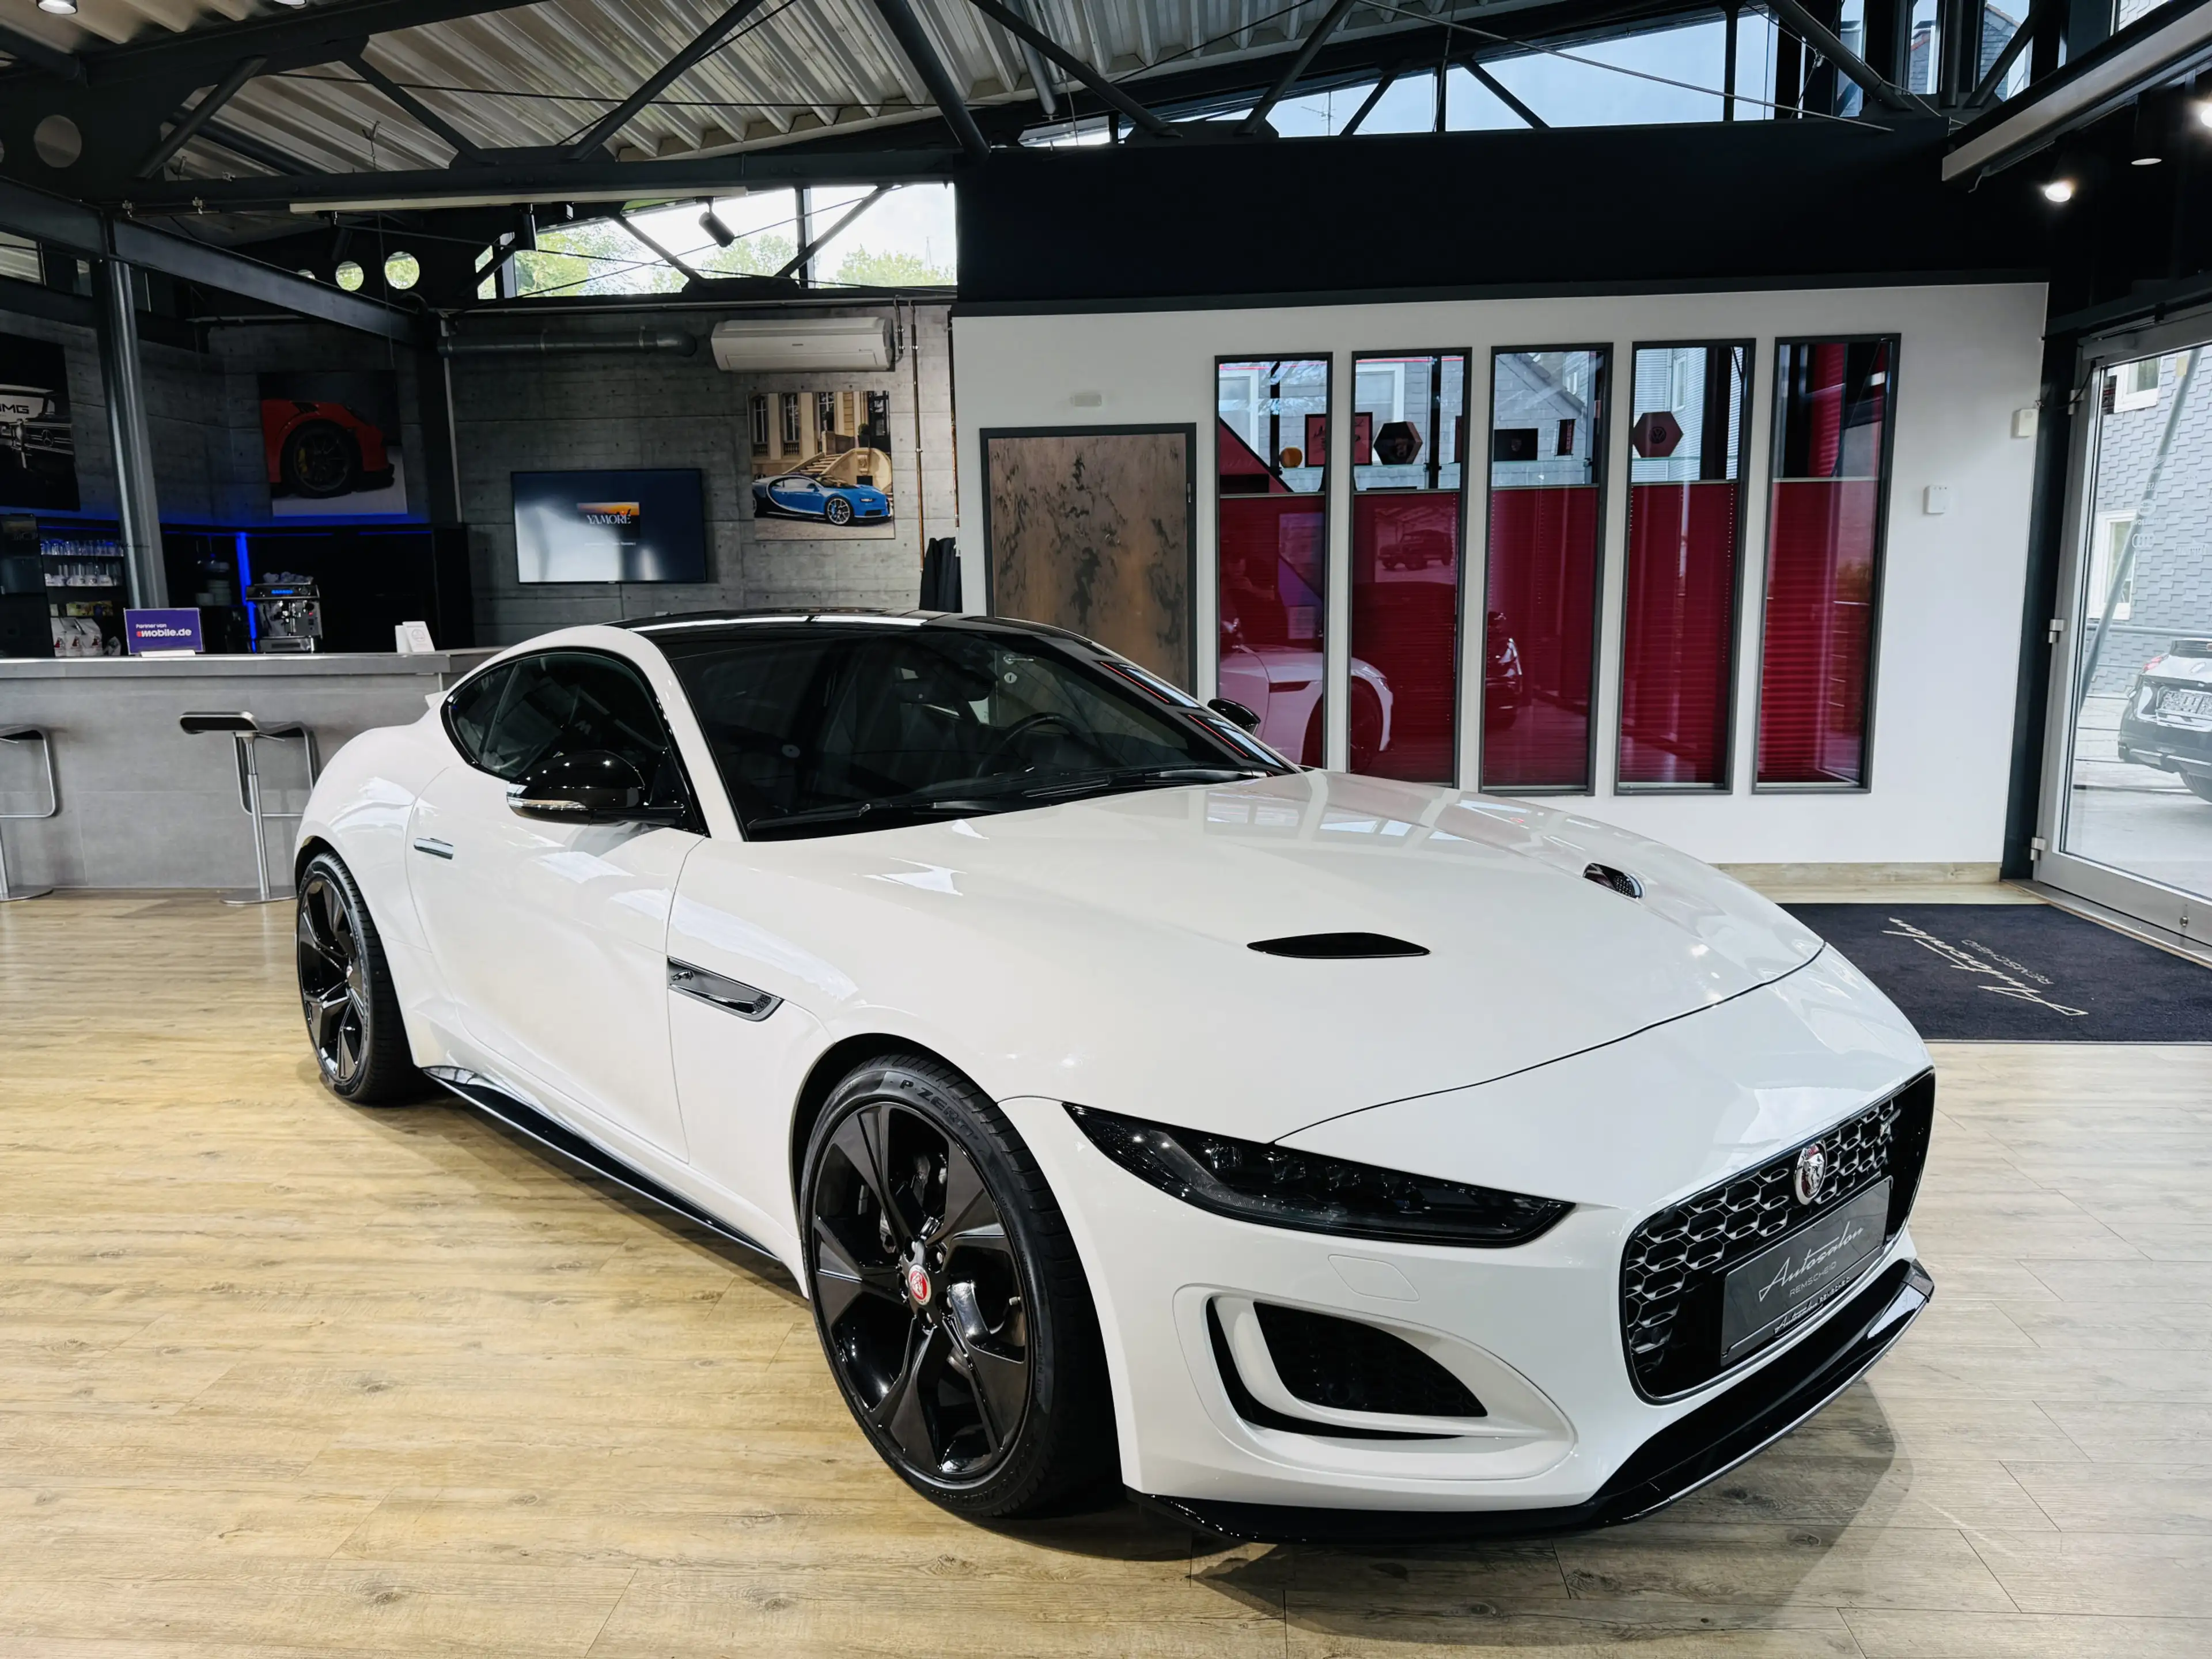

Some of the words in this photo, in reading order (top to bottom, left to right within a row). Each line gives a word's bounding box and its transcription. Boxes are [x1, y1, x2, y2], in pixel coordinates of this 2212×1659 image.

[0, 403, 29, 414] MG
[139, 628, 192, 637] mobile.de
[1759, 1221, 1864, 1302] Autosalon
[1789, 1260, 1837, 1297] REMSCHEID
